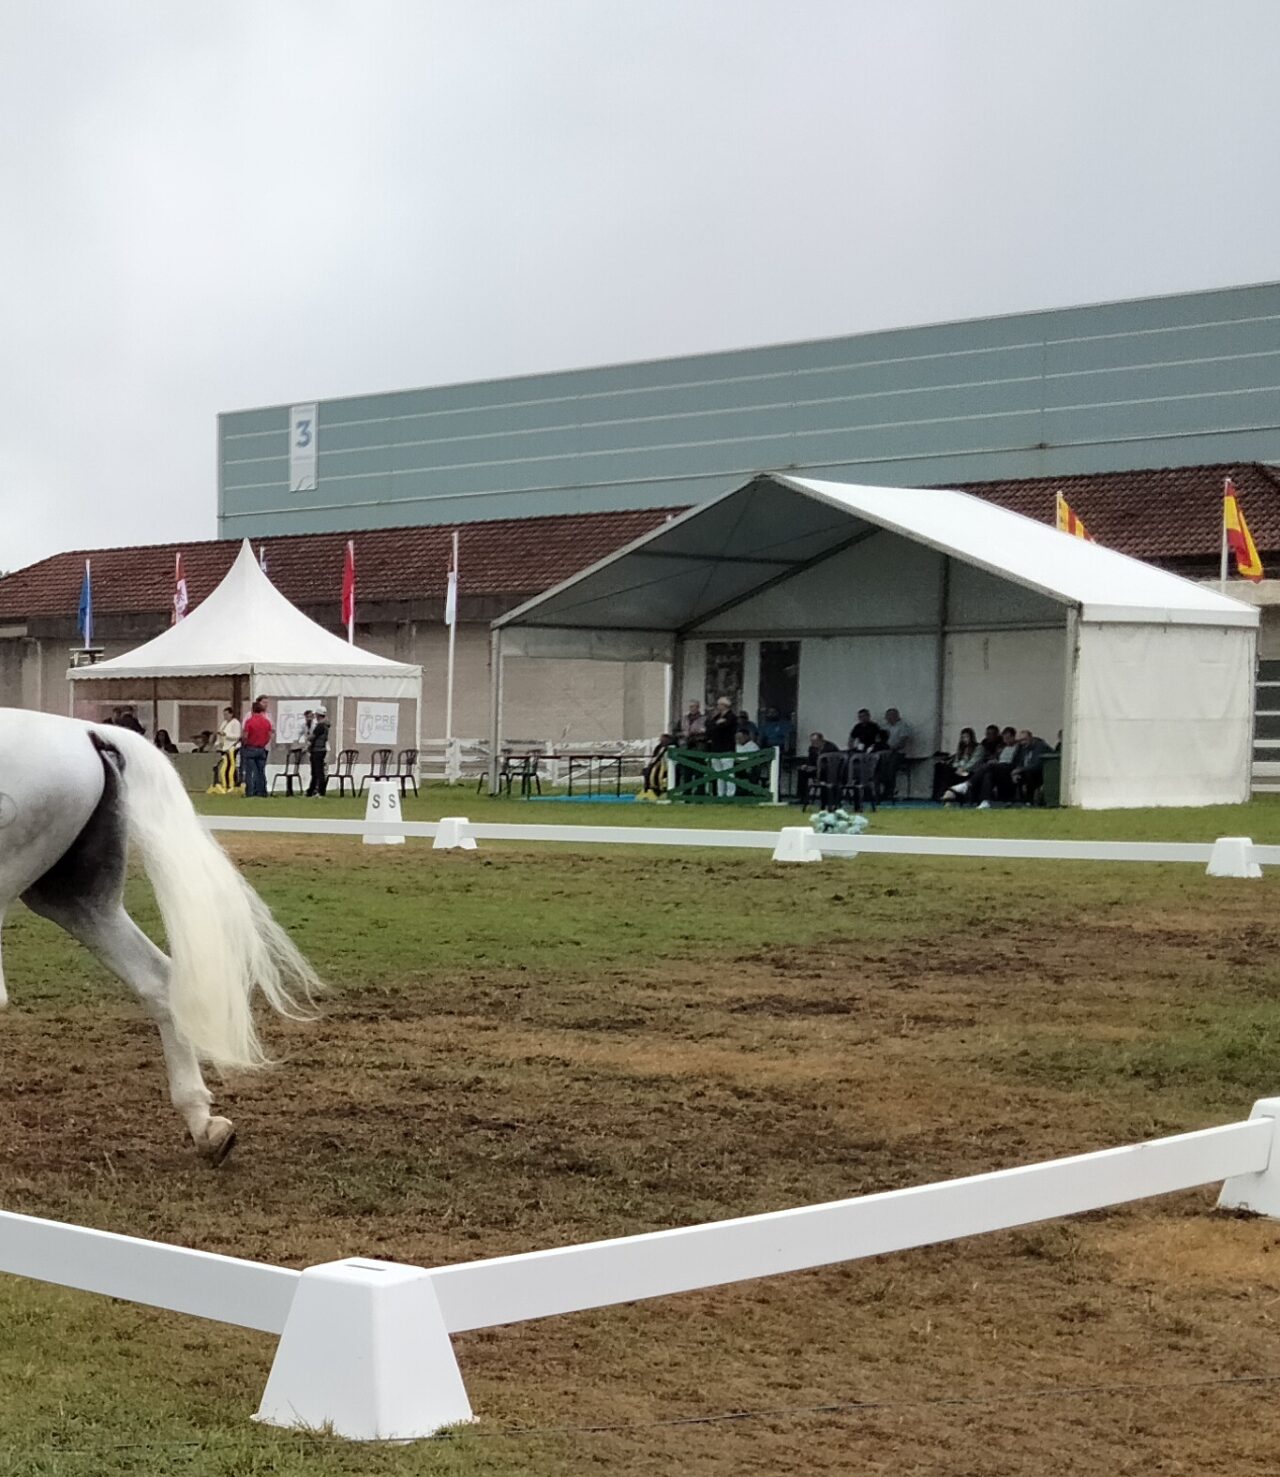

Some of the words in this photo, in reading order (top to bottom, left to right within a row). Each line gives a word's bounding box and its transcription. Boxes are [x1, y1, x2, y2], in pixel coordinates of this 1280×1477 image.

[295, 419, 312, 448] 3
[372, 794, 381, 809] S
[388, 793, 396, 809] S
